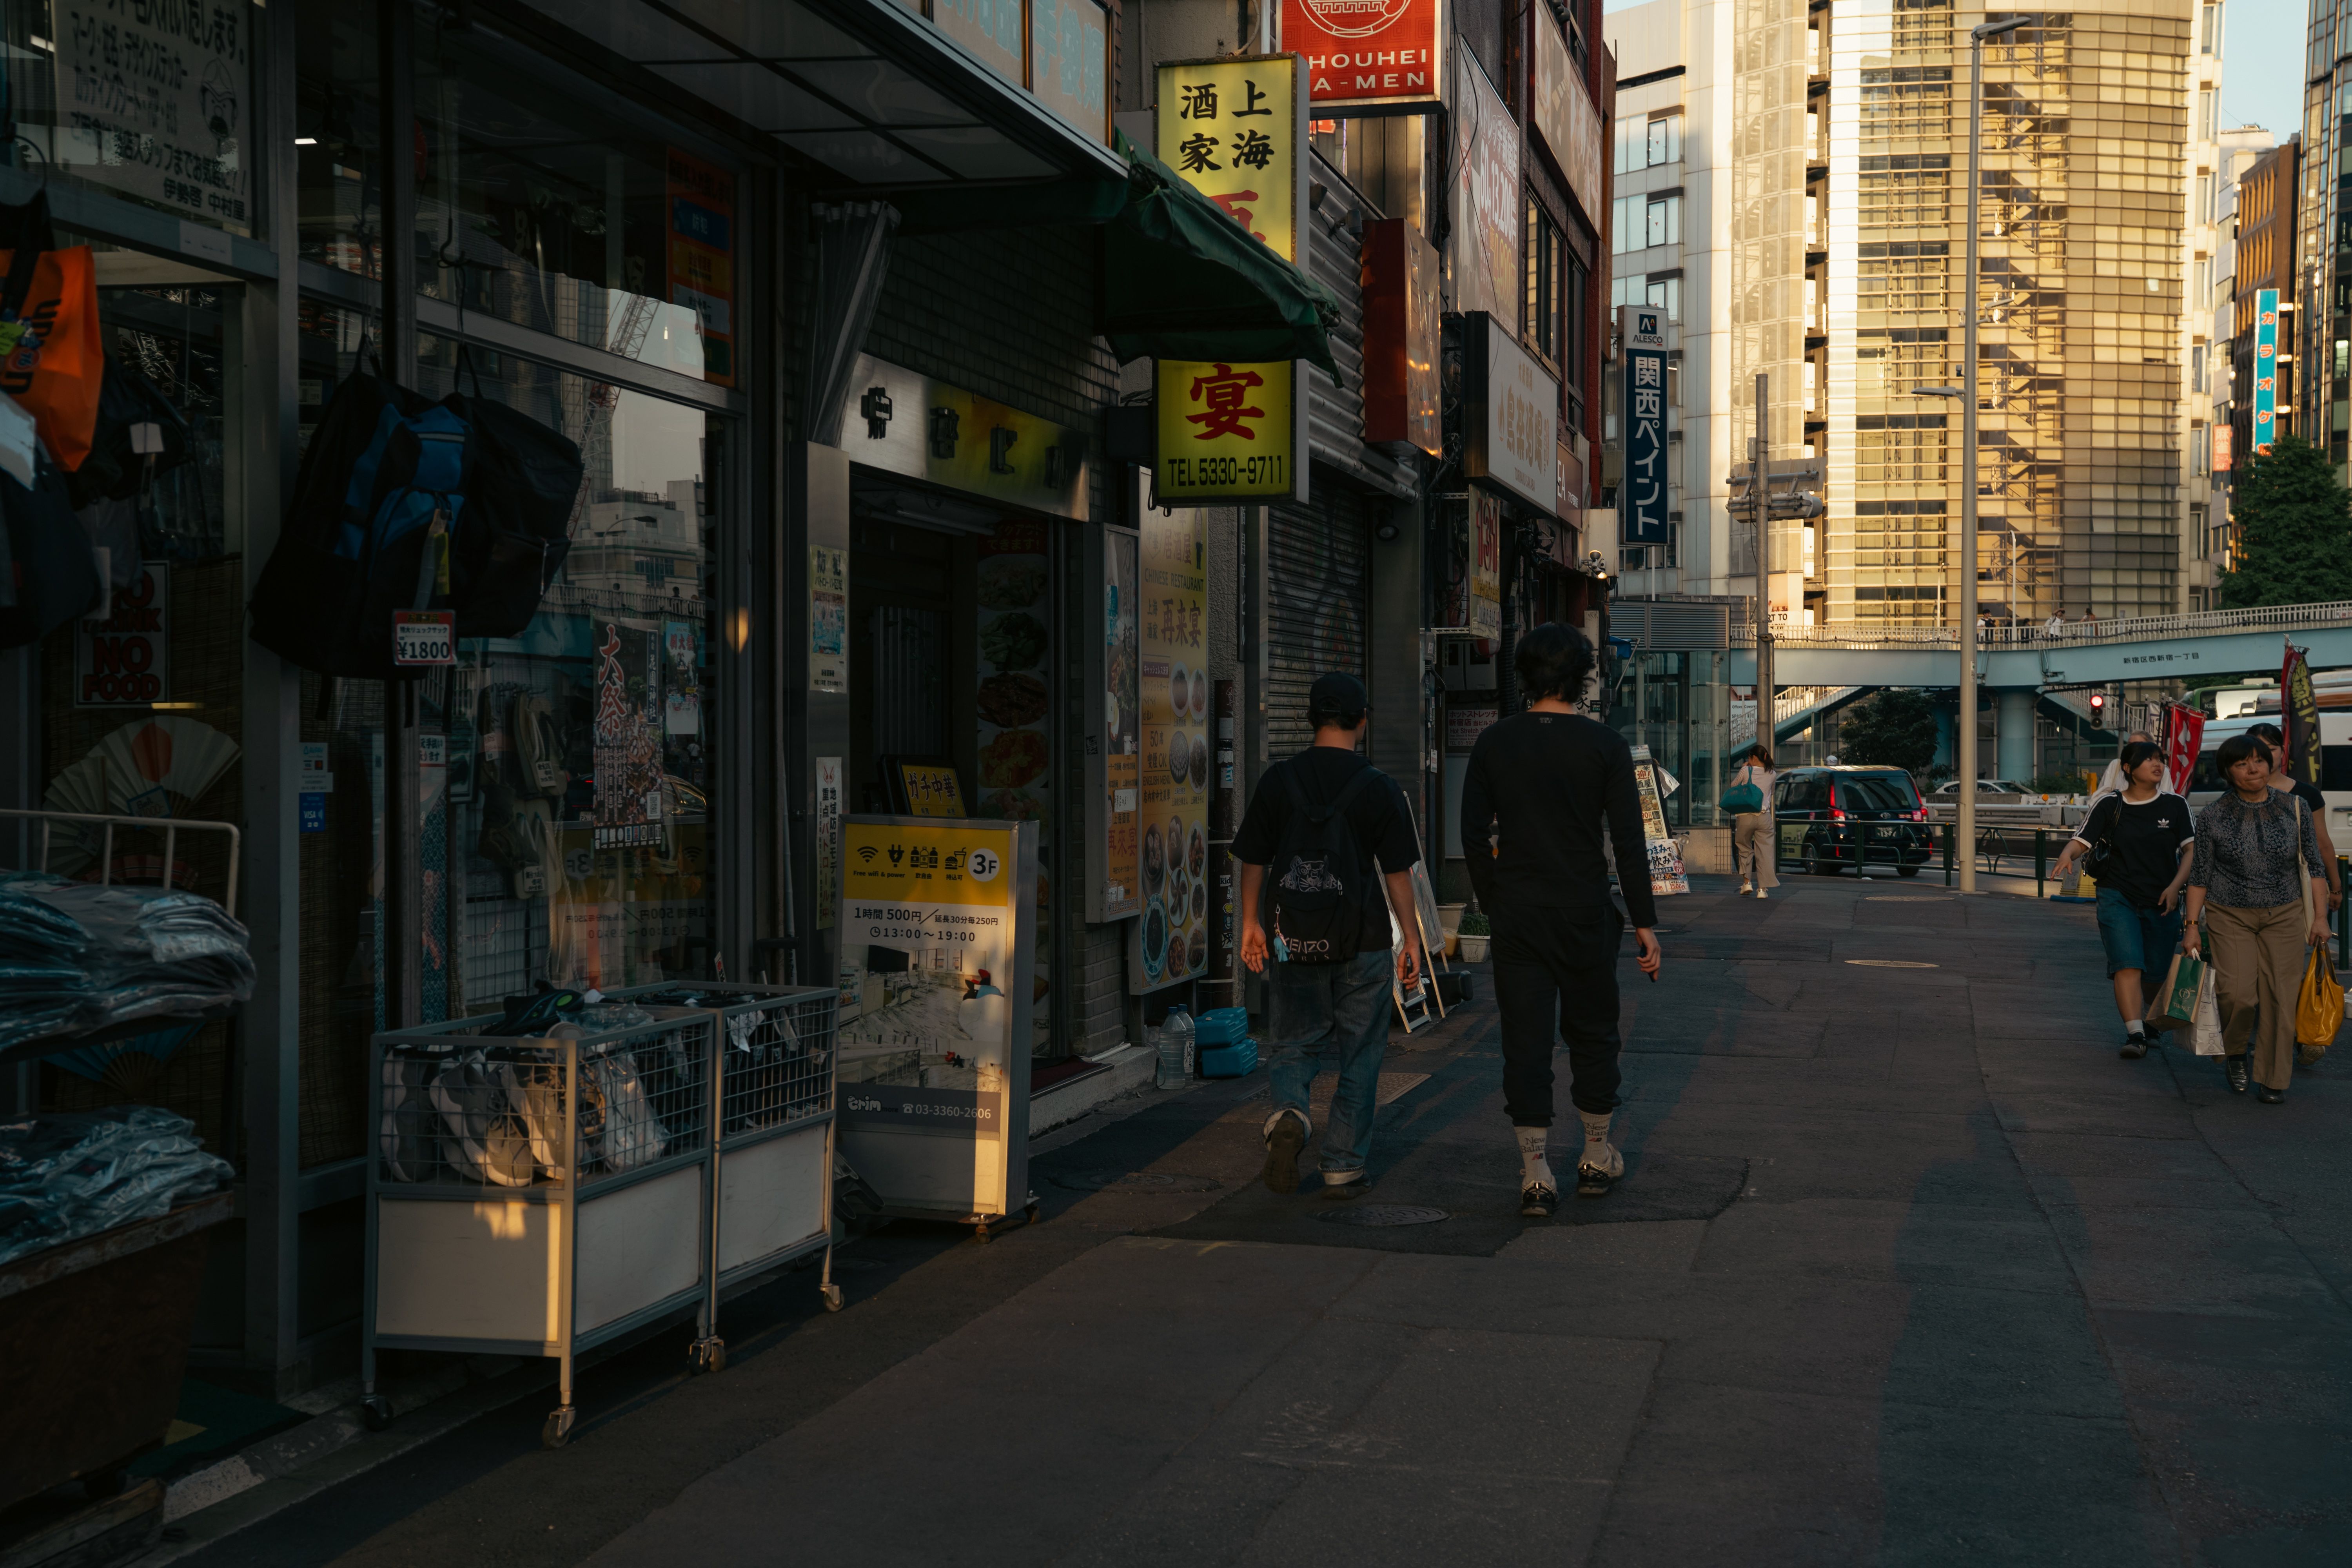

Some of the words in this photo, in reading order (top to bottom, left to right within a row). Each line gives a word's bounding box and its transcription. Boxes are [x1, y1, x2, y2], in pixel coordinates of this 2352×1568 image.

[1633, 334, 1663, 344] ALESCO
[1635, 356, 1661, 535] 関西ペイント
[1168, 458, 1196, 487] TEL
[1199, 455, 1282, 485] 5330-9711
[1144, 567, 1169, 586] CHINESE
[1171, 573, 1203, 592] RESTAURANT
[93, 636, 153, 674] NO
[398, 641, 449, 659] ¥1800
[2123, 652, 2200, 664] 新宿区西新宿一丁目
[83, 674, 161, 701] FOOD
[907, 771, 957, 804] ガチ中華
[1143, 775, 1159, 786] ENGLISH
[1160, 775, 1171, 784] MENU
[972, 853, 998, 875] 3F
[853, 869, 866, 878] Free
[868, 870, 879, 878] wifi
[887, 871, 906, 880] power
[946, 873, 963, 882] 持込可
[1220, 877, 1232, 885] kid
[854, 906, 883, 920] 1時間
[886, 908, 922, 923] 500円
[1289, 953, 1329, 961] ARIS
[915, 1104, 991, 1120] 03-3360-2606
